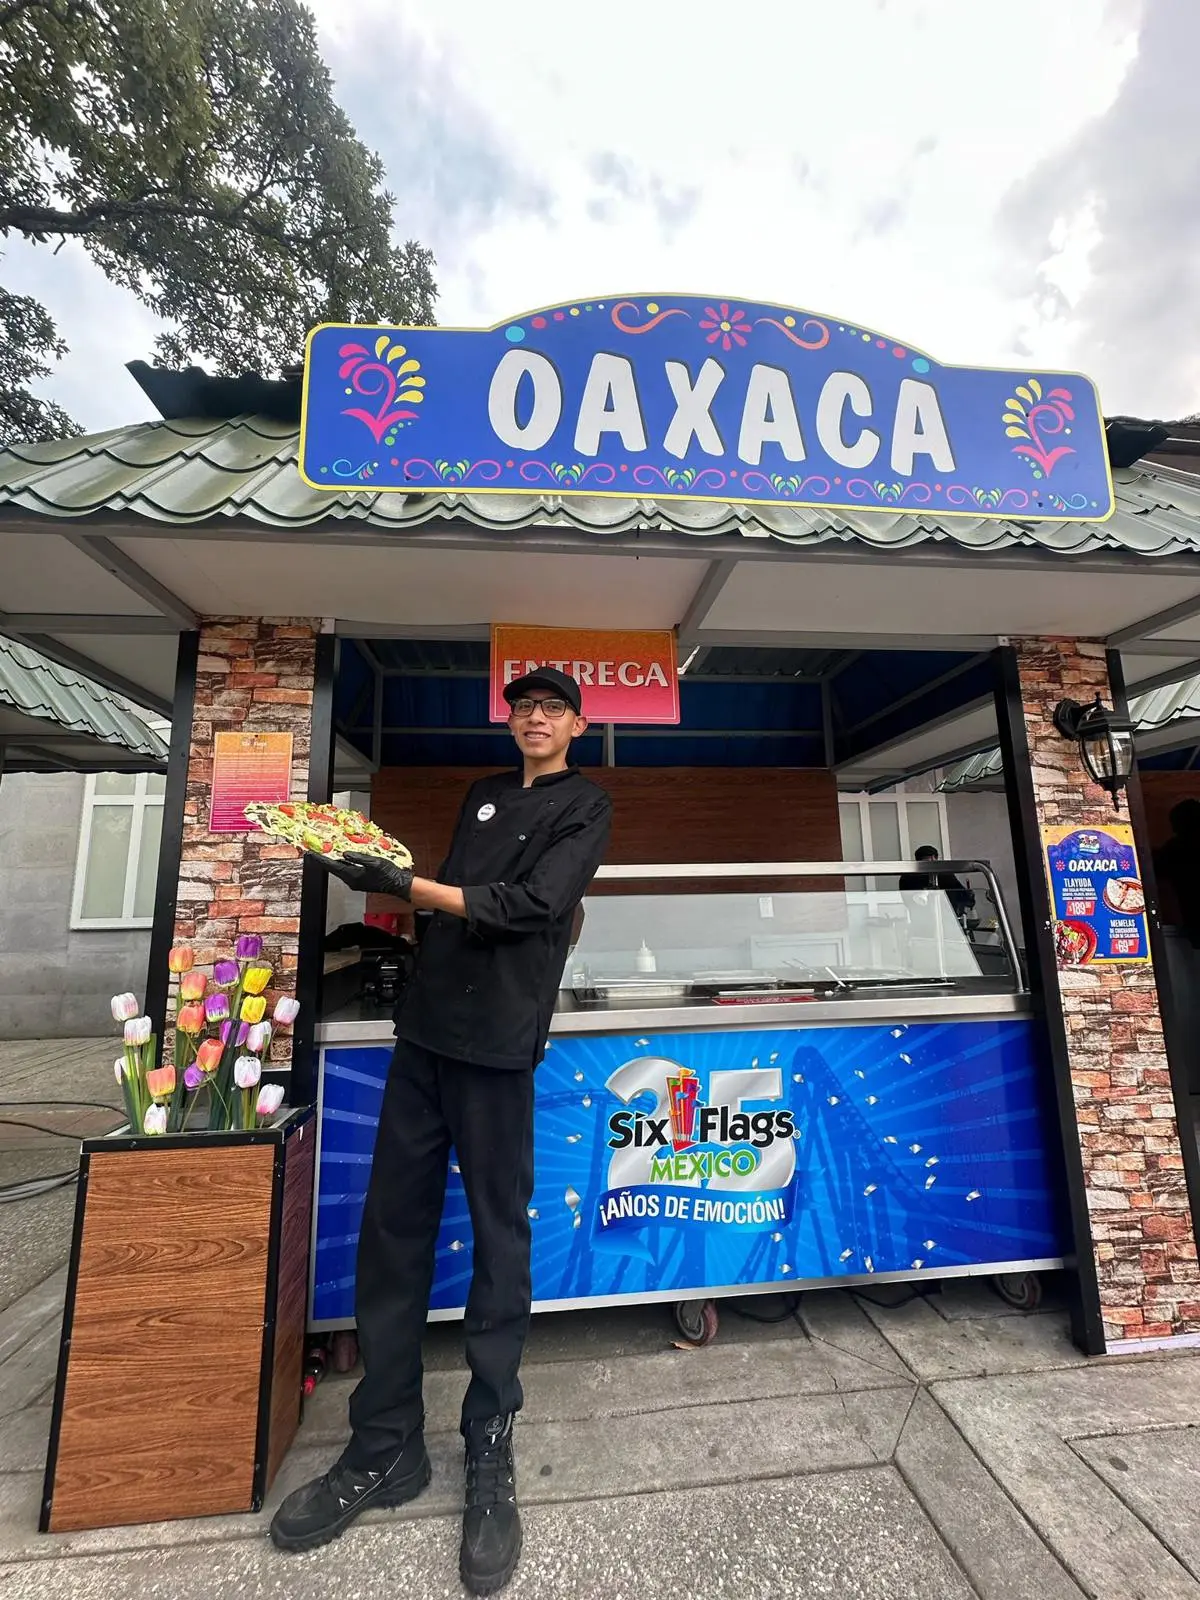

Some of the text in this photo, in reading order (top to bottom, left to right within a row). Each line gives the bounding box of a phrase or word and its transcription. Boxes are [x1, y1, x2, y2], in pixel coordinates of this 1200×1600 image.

[487, 348, 956, 477] OAXACA
[1064, 877, 1092, 887] TLAYUDA
[1068, 859, 1118, 872] OAXACA
[608, 1111, 670, 1149] Six
[649, 1150, 756, 1183] MEXICO
[600, 1191, 786, 1227] ¡AÑOS DE EMOCIÓN!
